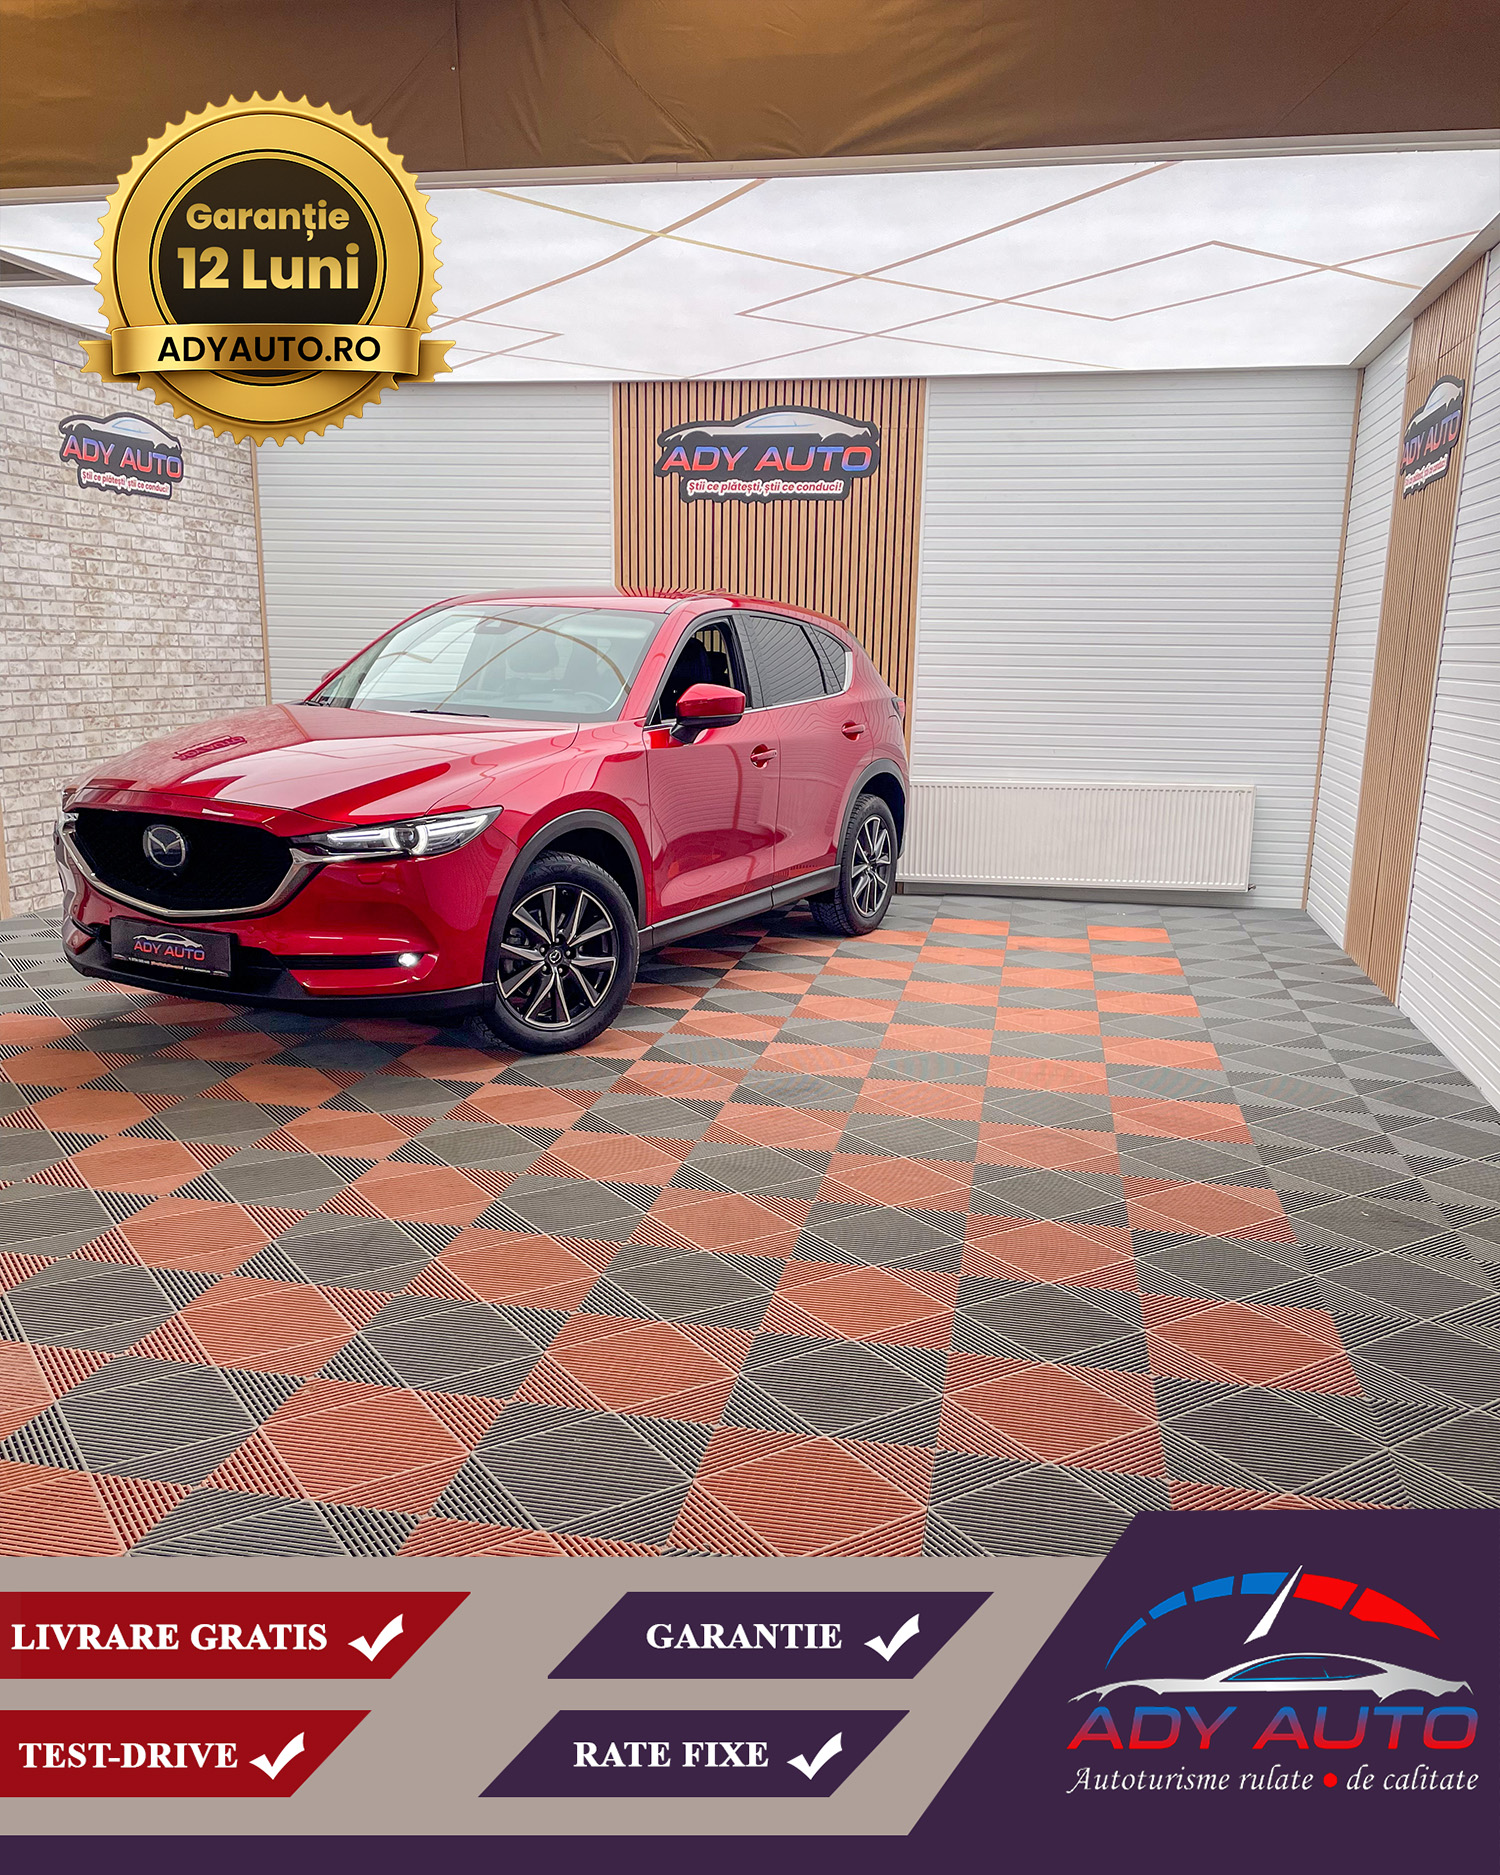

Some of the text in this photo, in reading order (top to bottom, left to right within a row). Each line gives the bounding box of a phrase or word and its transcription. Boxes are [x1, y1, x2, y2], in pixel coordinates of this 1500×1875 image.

[1400, 410, 1460, 469] ADY AUTO
[62, 434, 181, 478] ADY AUTO
[661, 446, 872, 471] ADY AUTO
[707, 483, 719, 491] ce
[782, 483, 795, 491] ce
[796, 481, 842, 491] conduci!
[133, 940, 205, 961] ADY AUTO
